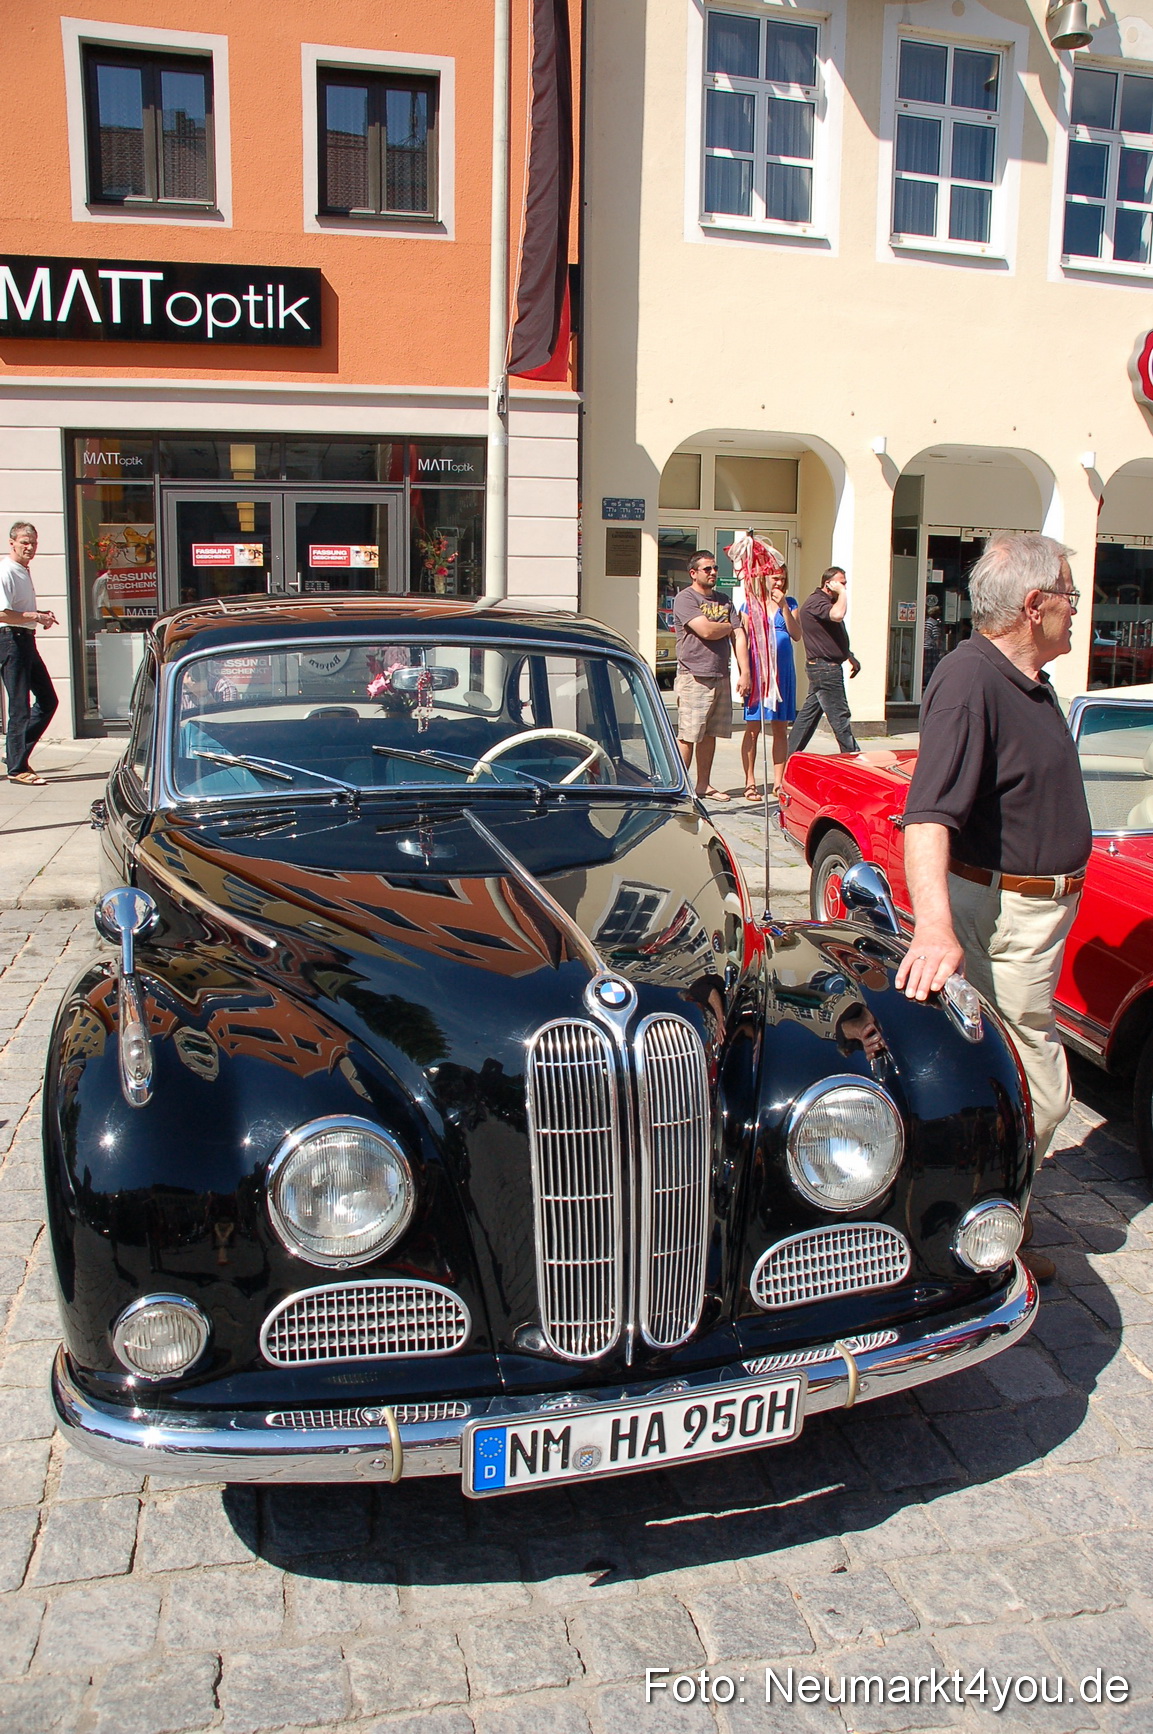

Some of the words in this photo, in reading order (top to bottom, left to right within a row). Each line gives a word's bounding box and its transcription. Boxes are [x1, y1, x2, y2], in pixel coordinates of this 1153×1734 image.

[214, 658, 267, 668] SSUNG
[509, 1425, 571, 1478] NM
[610, 1411, 667, 1462] HA
[683, 1387, 795, 1450] 950H
[484, 1465, 496, 1480] D
